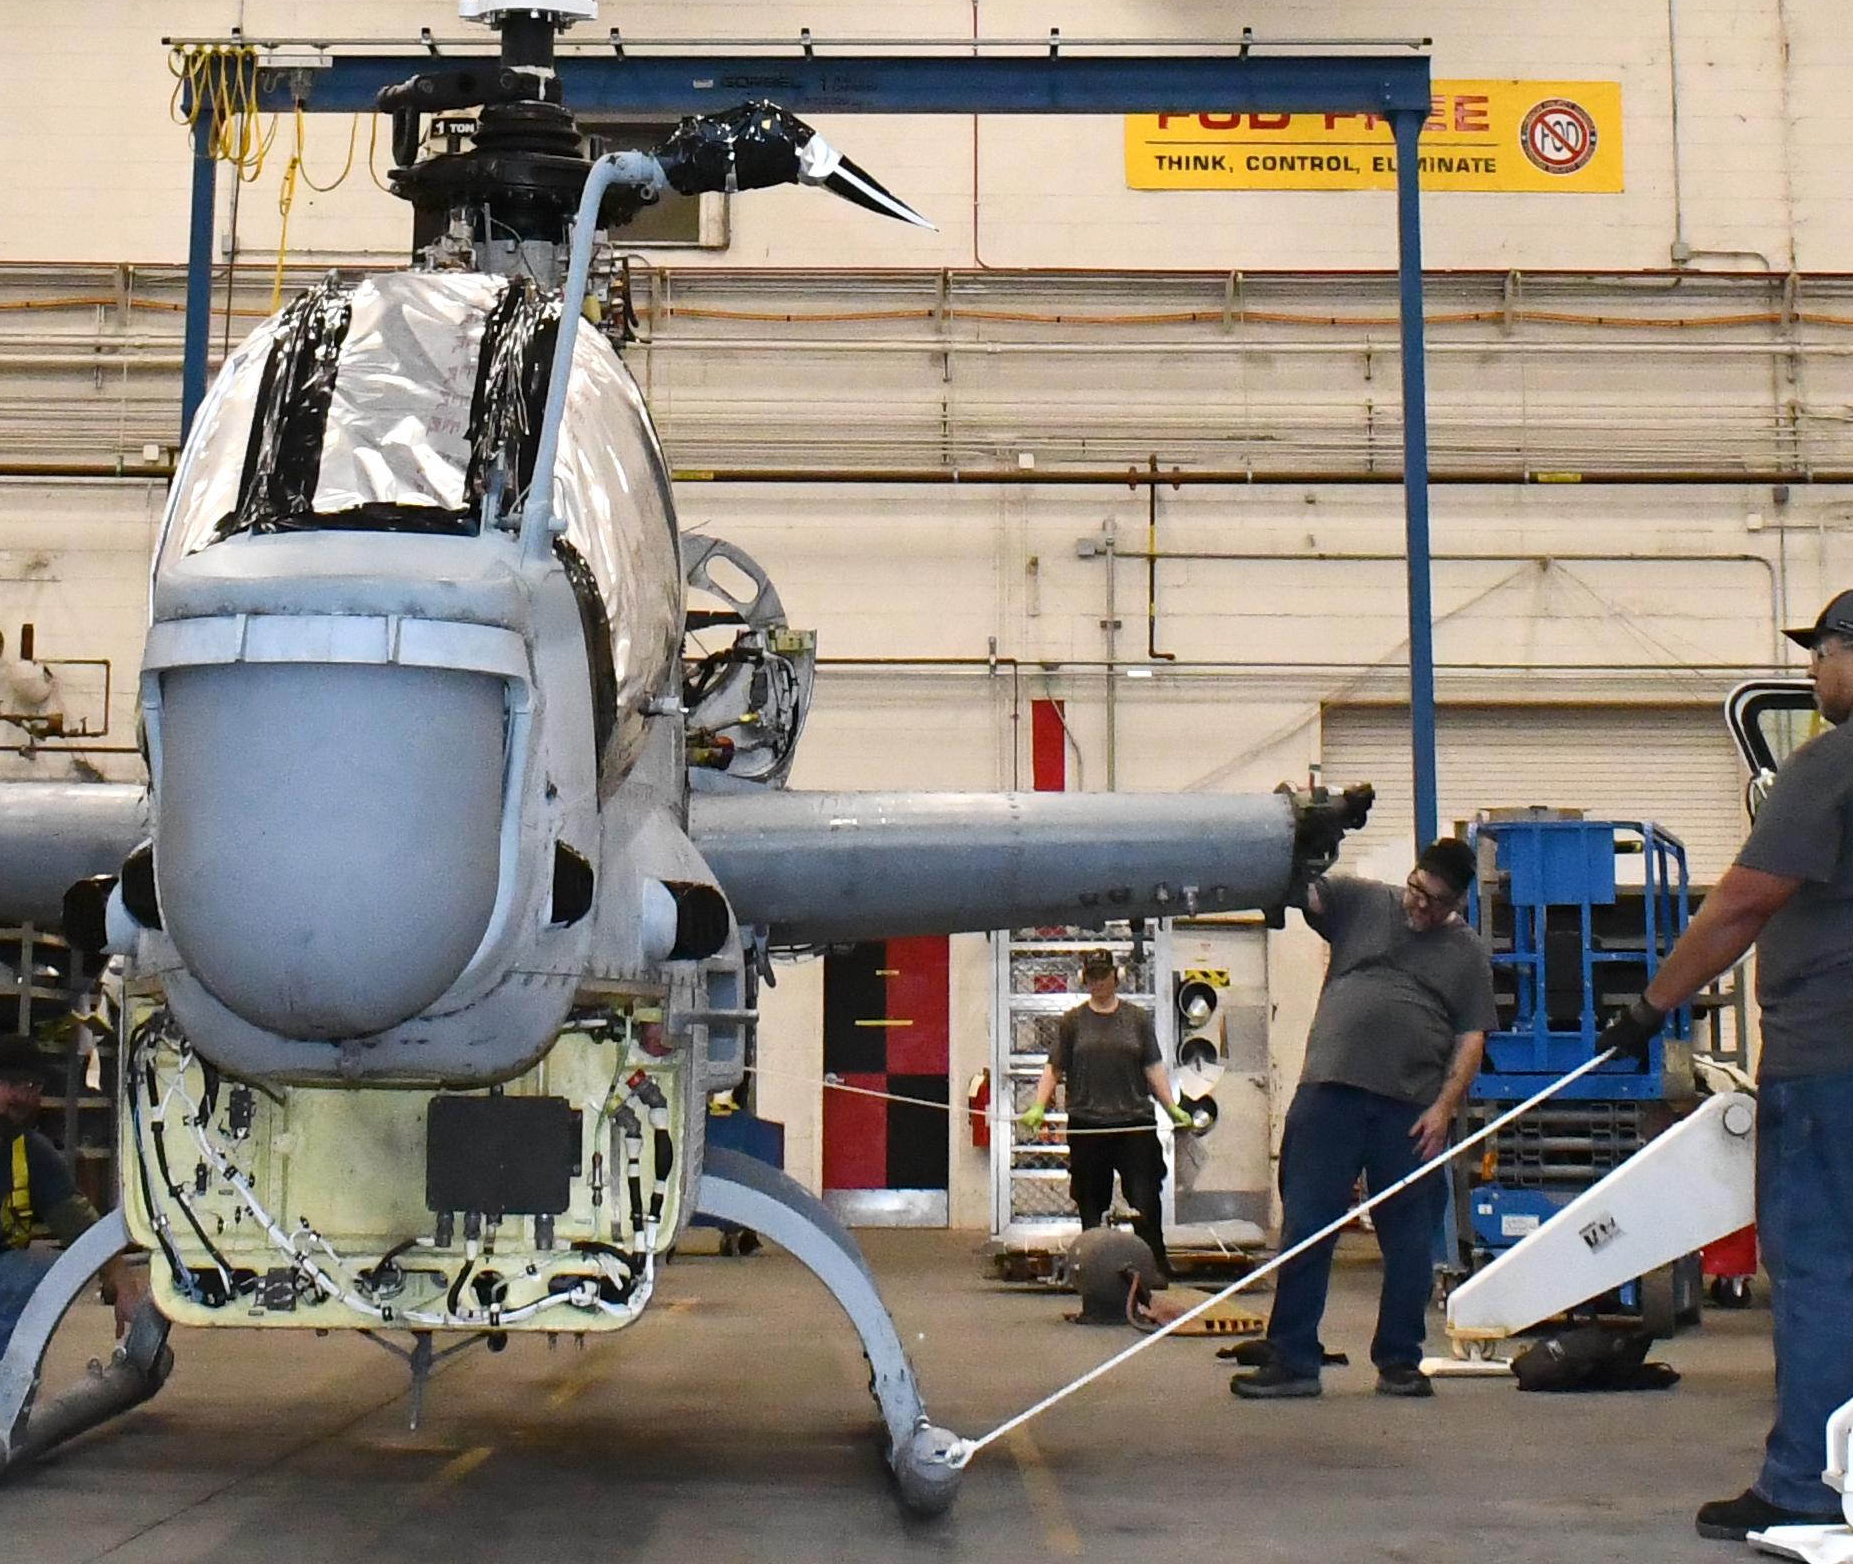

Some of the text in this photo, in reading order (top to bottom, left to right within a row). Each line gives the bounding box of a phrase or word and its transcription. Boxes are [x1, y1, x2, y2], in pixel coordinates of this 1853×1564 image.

[449, 123, 475, 134] TON
[1154, 155, 1496, 174] THINK, CONTROL, ELINATE
